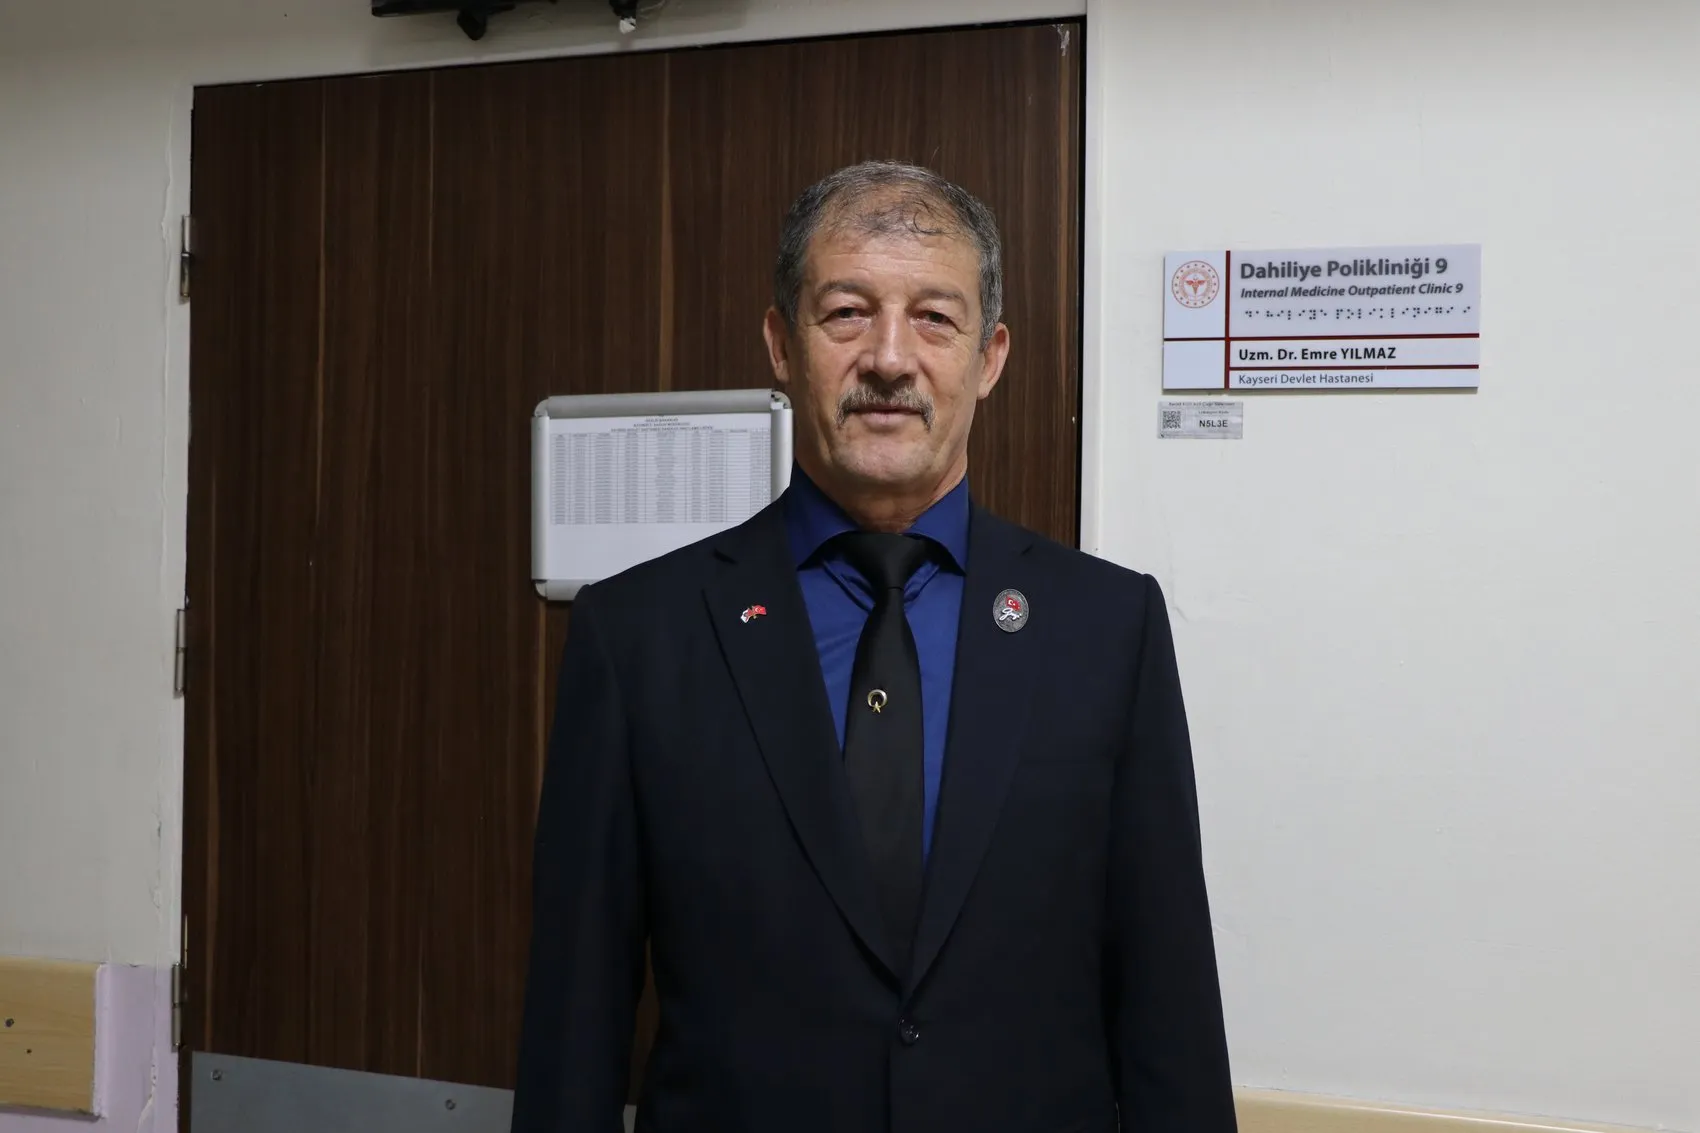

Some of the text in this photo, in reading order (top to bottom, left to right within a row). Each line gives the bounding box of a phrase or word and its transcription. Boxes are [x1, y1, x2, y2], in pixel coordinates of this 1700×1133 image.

[1241, 259, 1447, 282] Dahiliye Polikliniği 9
[1241, 283, 1463, 298] Internal Medicine Outpatient Clinic 9
[1239, 348, 1396, 360] Uzm. Dr. Emre YILMAZ
[1239, 373, 1373, 386] Kayseri Devlet Hastanesi
